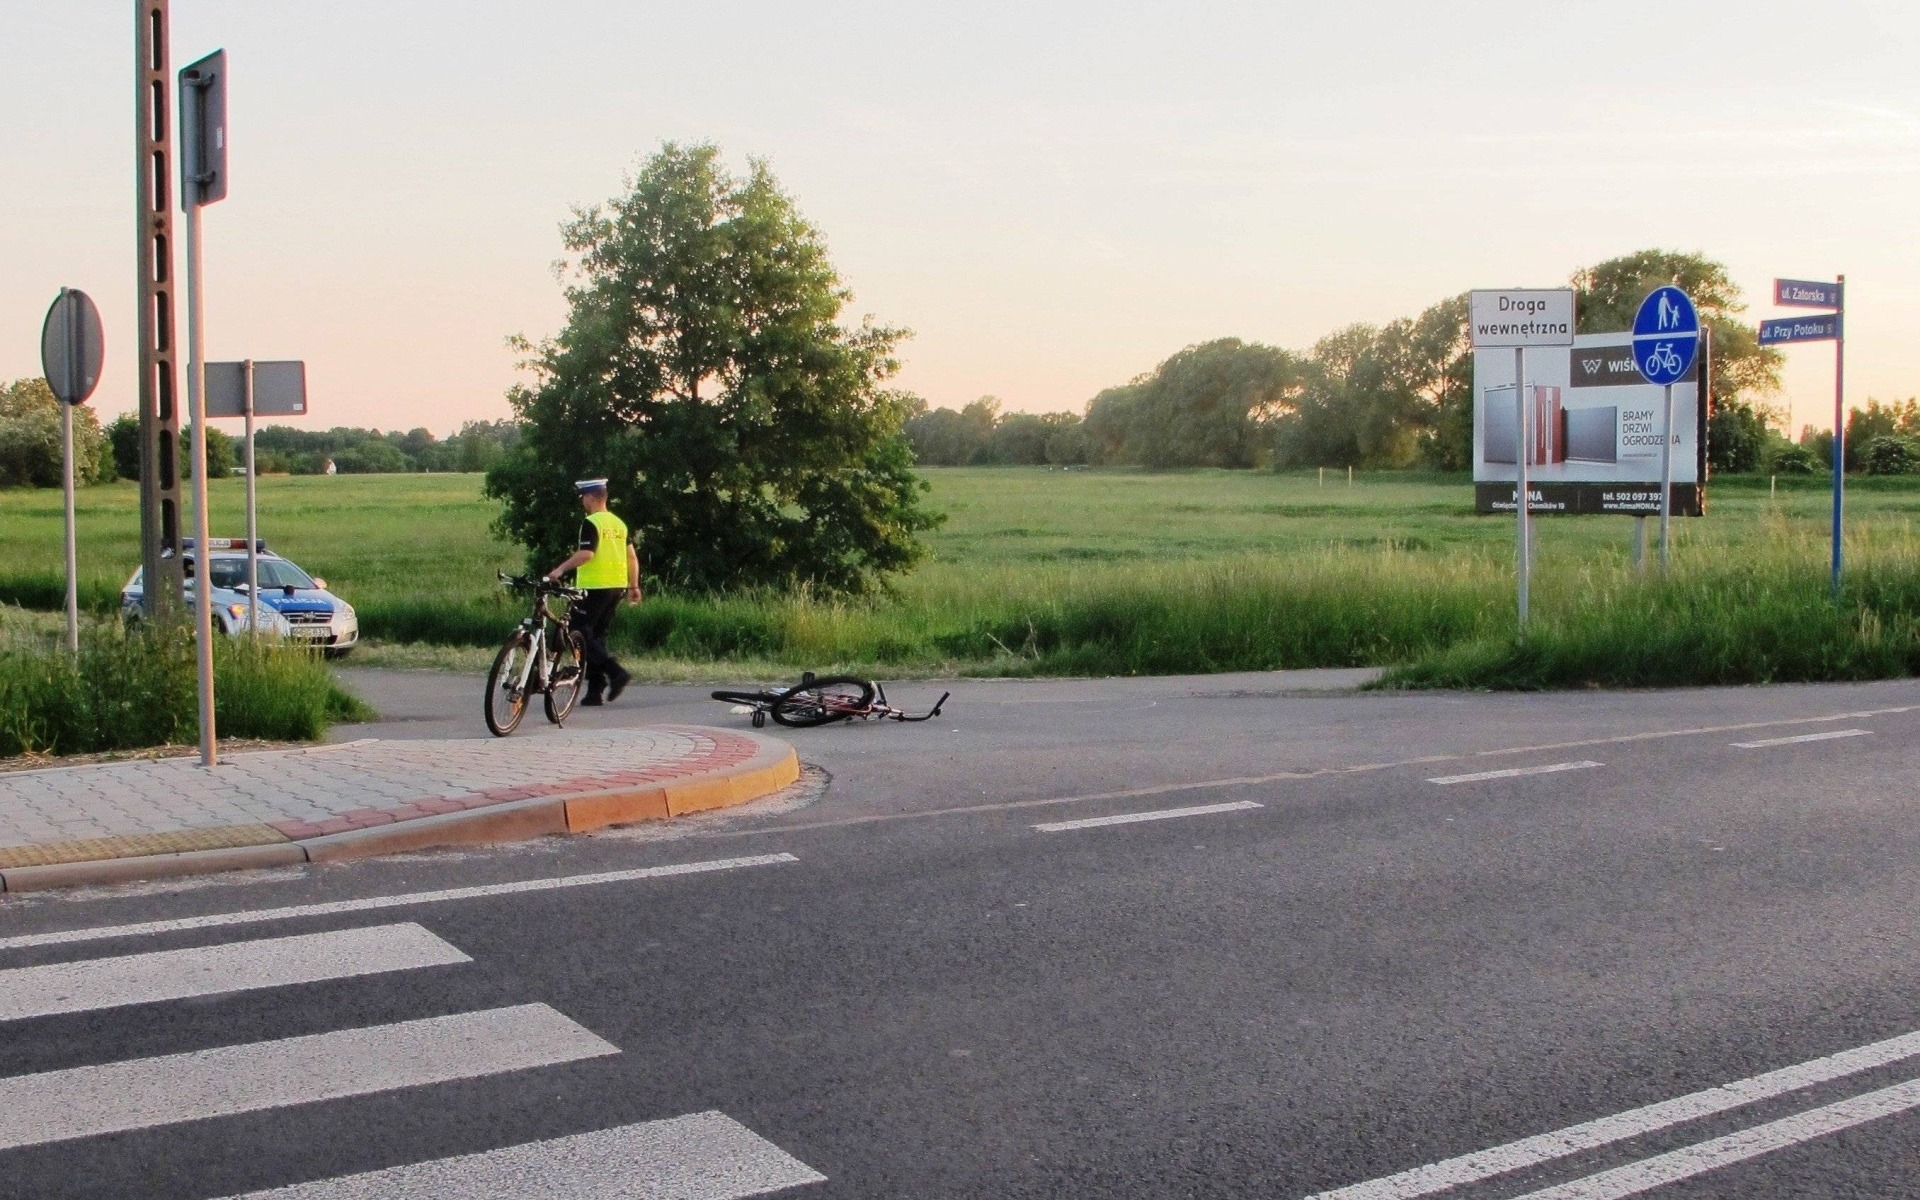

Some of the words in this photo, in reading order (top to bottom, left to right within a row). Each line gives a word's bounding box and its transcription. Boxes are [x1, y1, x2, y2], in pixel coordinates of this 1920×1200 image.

[1781, 287, 1790, 299] ul.
[1792, 287, 1825, 301] Zatorska
[1498, 296, 1545, 315] Droga
[1478, 321, 1567, 339] wewnętrzna
[1762, 327, 1771, 338] ul.
[1773, 326, 1792, 339] Przy
[1794, 323, 1824, 335] Potoku
[1608, 358, 1640, 372] WIŚN
[1622, 410, 1654, 421] BRAMY
[1622, 423, 1652, 433] DRZWI
[1622, 435, 1681, 446] OGRODZEIA
[1512, 490, 1543, 501] MNA
[1602, 492, 1614, 500] tel.
[1616, 492, 1631, 500] 502
[1632, 492, 1647, 501] 097
[1603, 502, 1662, 510] www.firmaMONA.p
